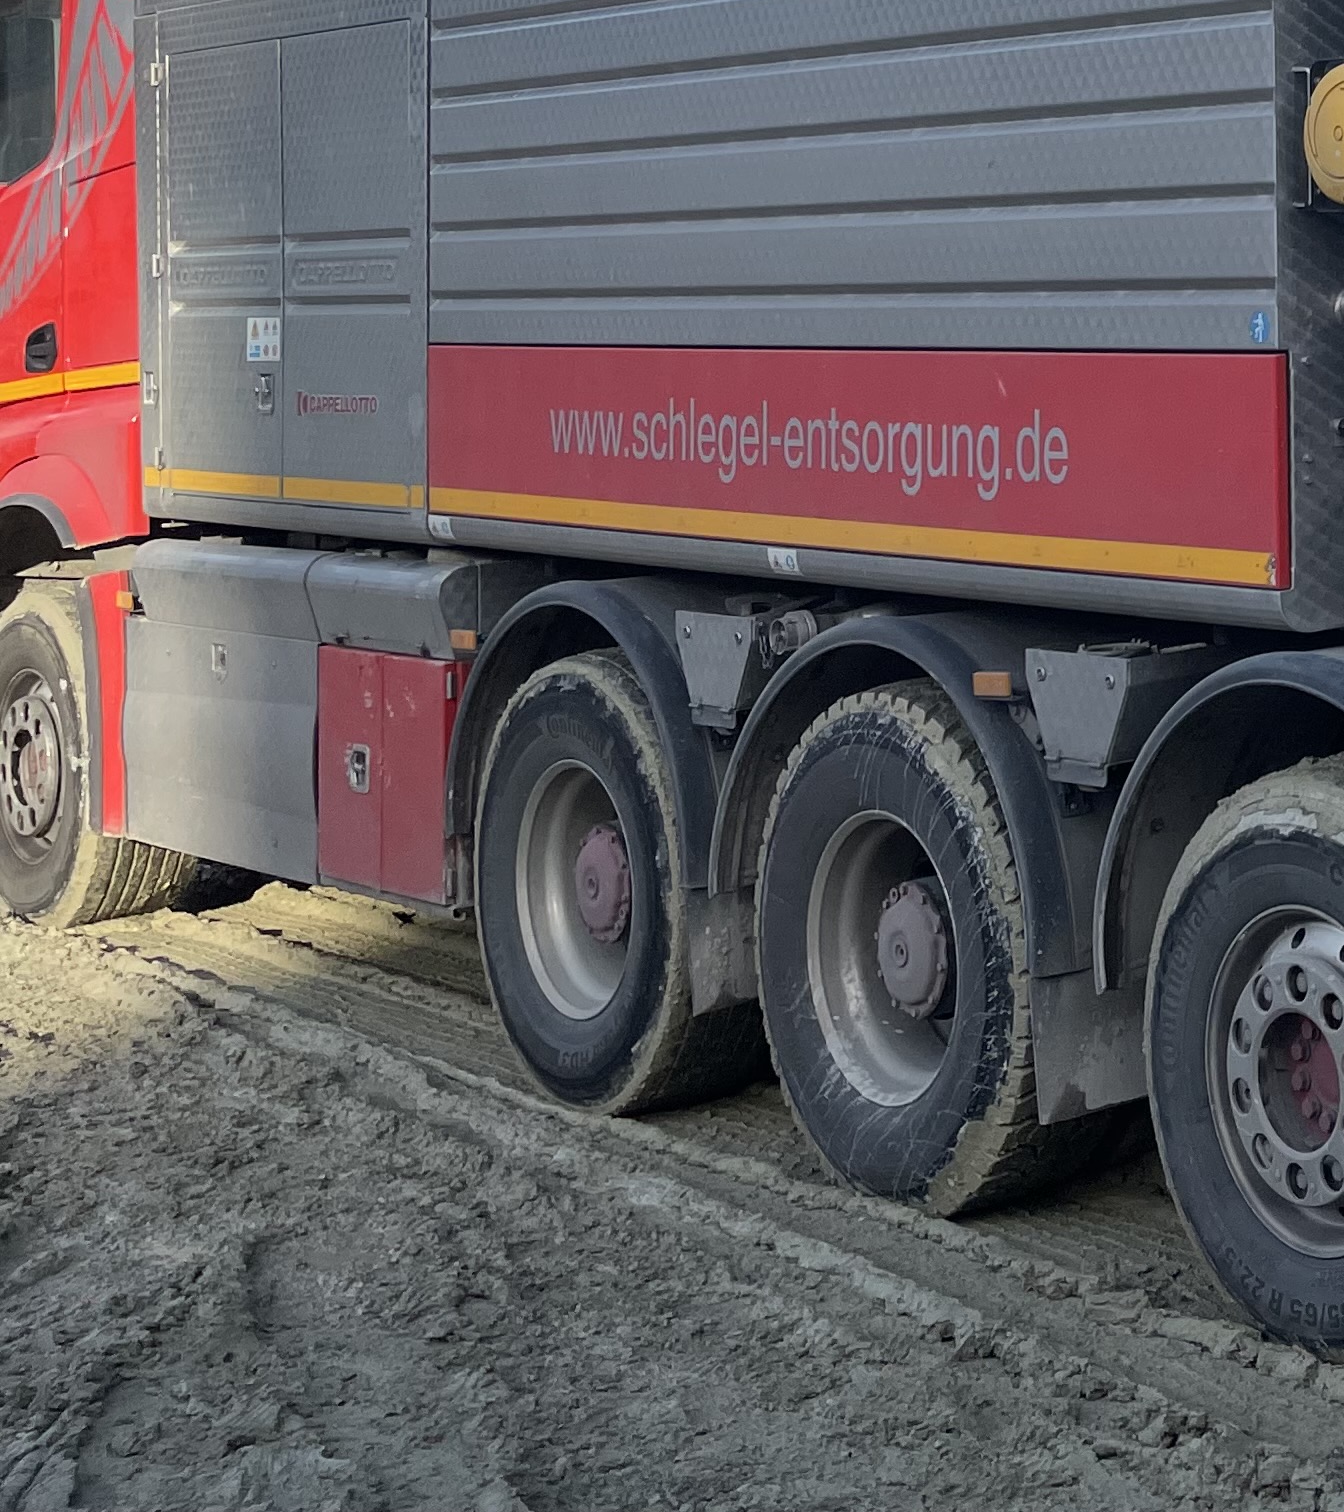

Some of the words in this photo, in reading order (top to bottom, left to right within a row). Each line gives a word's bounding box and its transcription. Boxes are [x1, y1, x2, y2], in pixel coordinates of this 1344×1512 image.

[309, 394, 378, 415] CAPPELLOTTO
[549, 397, 1069, 501] www.schlegel-entsorgung.de
[1267, 1287, 1284, 1317] R
